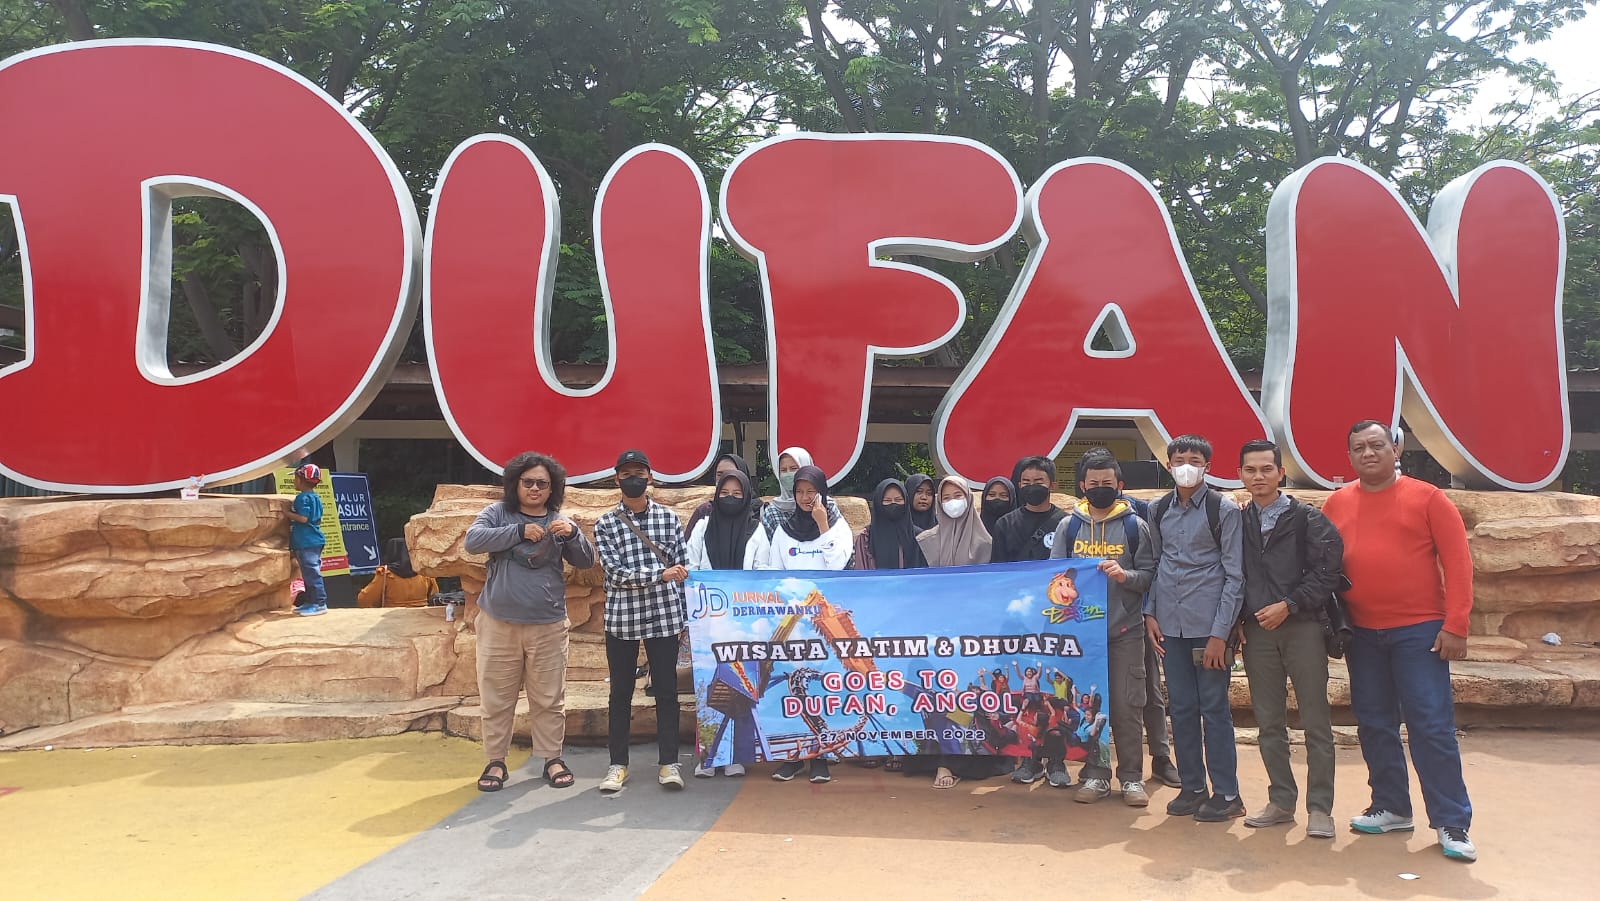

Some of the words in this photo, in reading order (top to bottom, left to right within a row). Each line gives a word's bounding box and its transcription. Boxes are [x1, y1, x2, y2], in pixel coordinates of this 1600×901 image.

[0, 38, 1568, 492] DUFAN
[335, 493, 365, 502] JALUR
[338, 503, 368, 517] ASUK
[341, 523, 370, 532] ntrance
[1073, 540, 1125, 555] Dickies
[732, 591, 785, 604] JURNAL
[732, 604, 822, 617] DERMAWANKU
[714, 641, 828, 663] WISATA
[835, 638, 928, 658] YATIM
[936, 638, 953, 656] &
[962, 635, 1081, 657] DHUAFA
[823, 670, 904, 692] GOES
[920, 670, 958, 690] TO
[784, 694, 898, 718] DUFAN,
[913, 691, 1018, 713] ANCOL
[820, 733, 838, 742] 27
[845, 730, 938, 742] NOVEMBER
[943, 729, 985, 740] 2022
